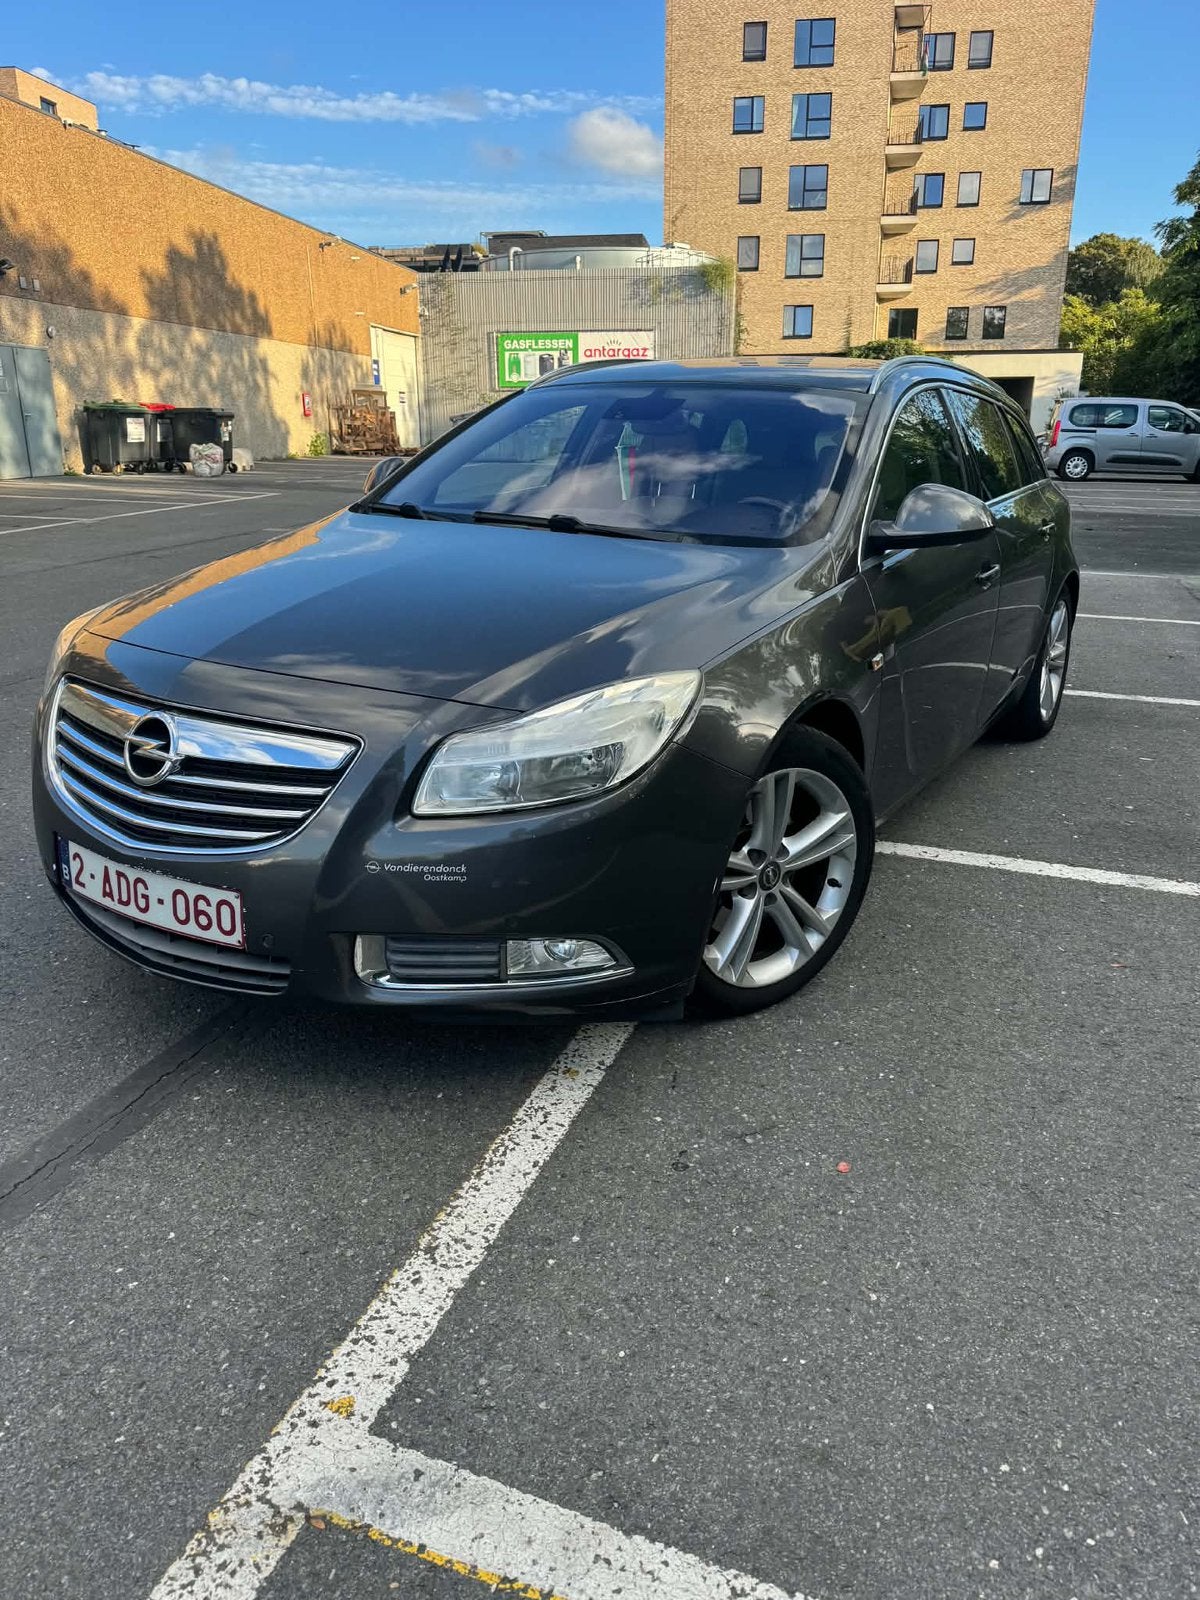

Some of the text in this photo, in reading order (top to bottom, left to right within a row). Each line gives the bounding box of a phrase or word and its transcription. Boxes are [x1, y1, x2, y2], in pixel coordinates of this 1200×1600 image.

[504, 339, 573, 349] GASFLESSEN
[61, 865, 70, 881] B
[384, 863, 467, 873] Vandierendonck
[424, 874, 467, 882] Oostkamp
[72, 852, 237, 937] 2-ADG-060
